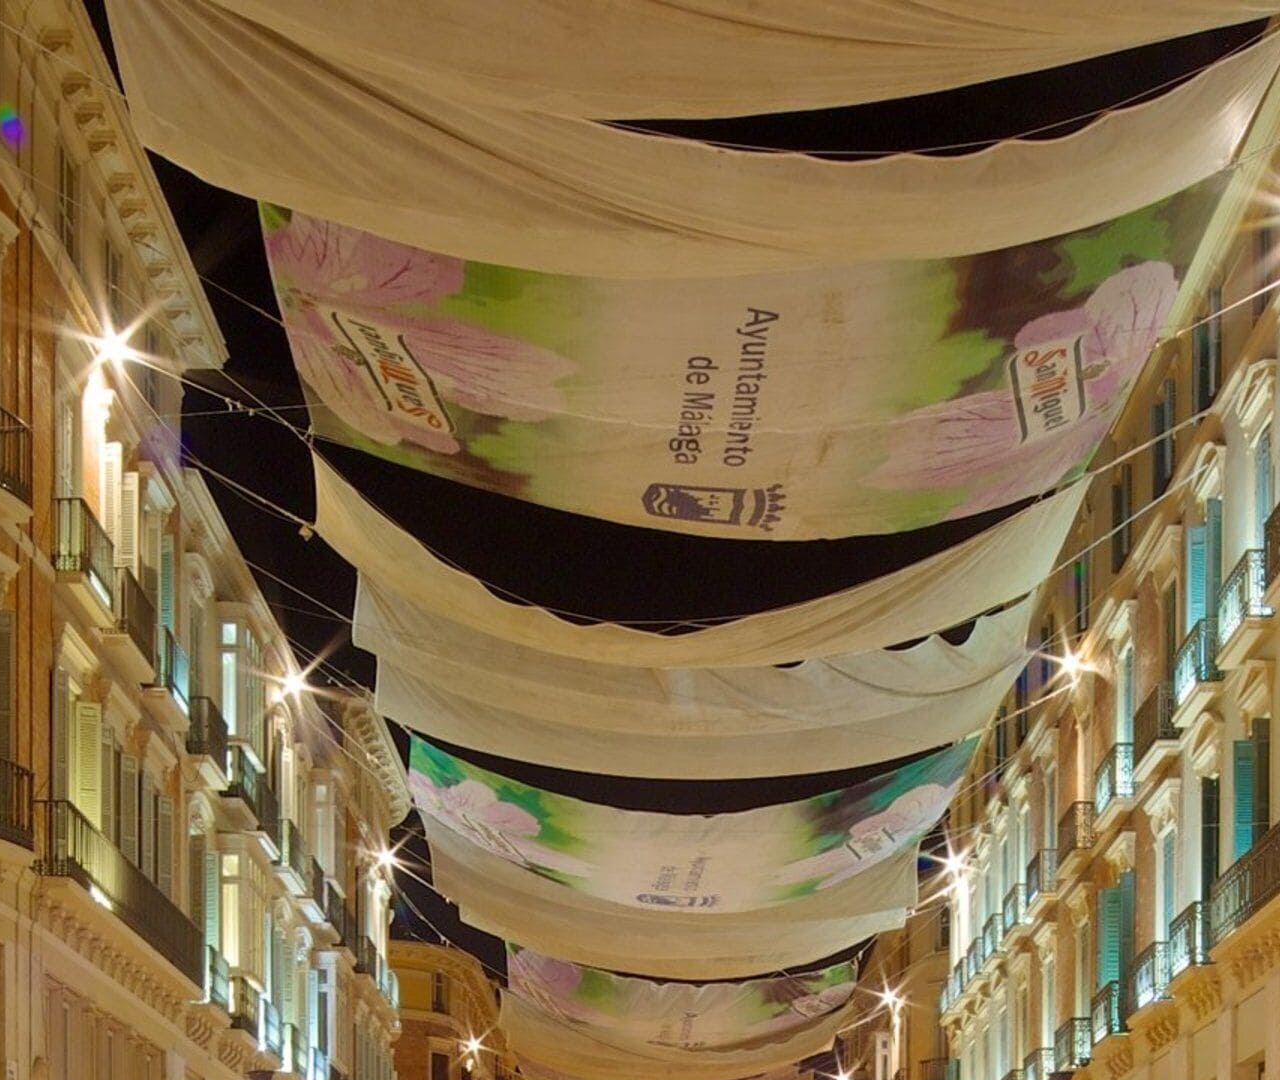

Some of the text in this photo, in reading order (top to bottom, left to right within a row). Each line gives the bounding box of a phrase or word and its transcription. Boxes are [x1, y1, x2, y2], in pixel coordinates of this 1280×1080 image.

[669, 356, 719, 465] de Málaga
[724, 307, 780, 467] Ayuntamiento
